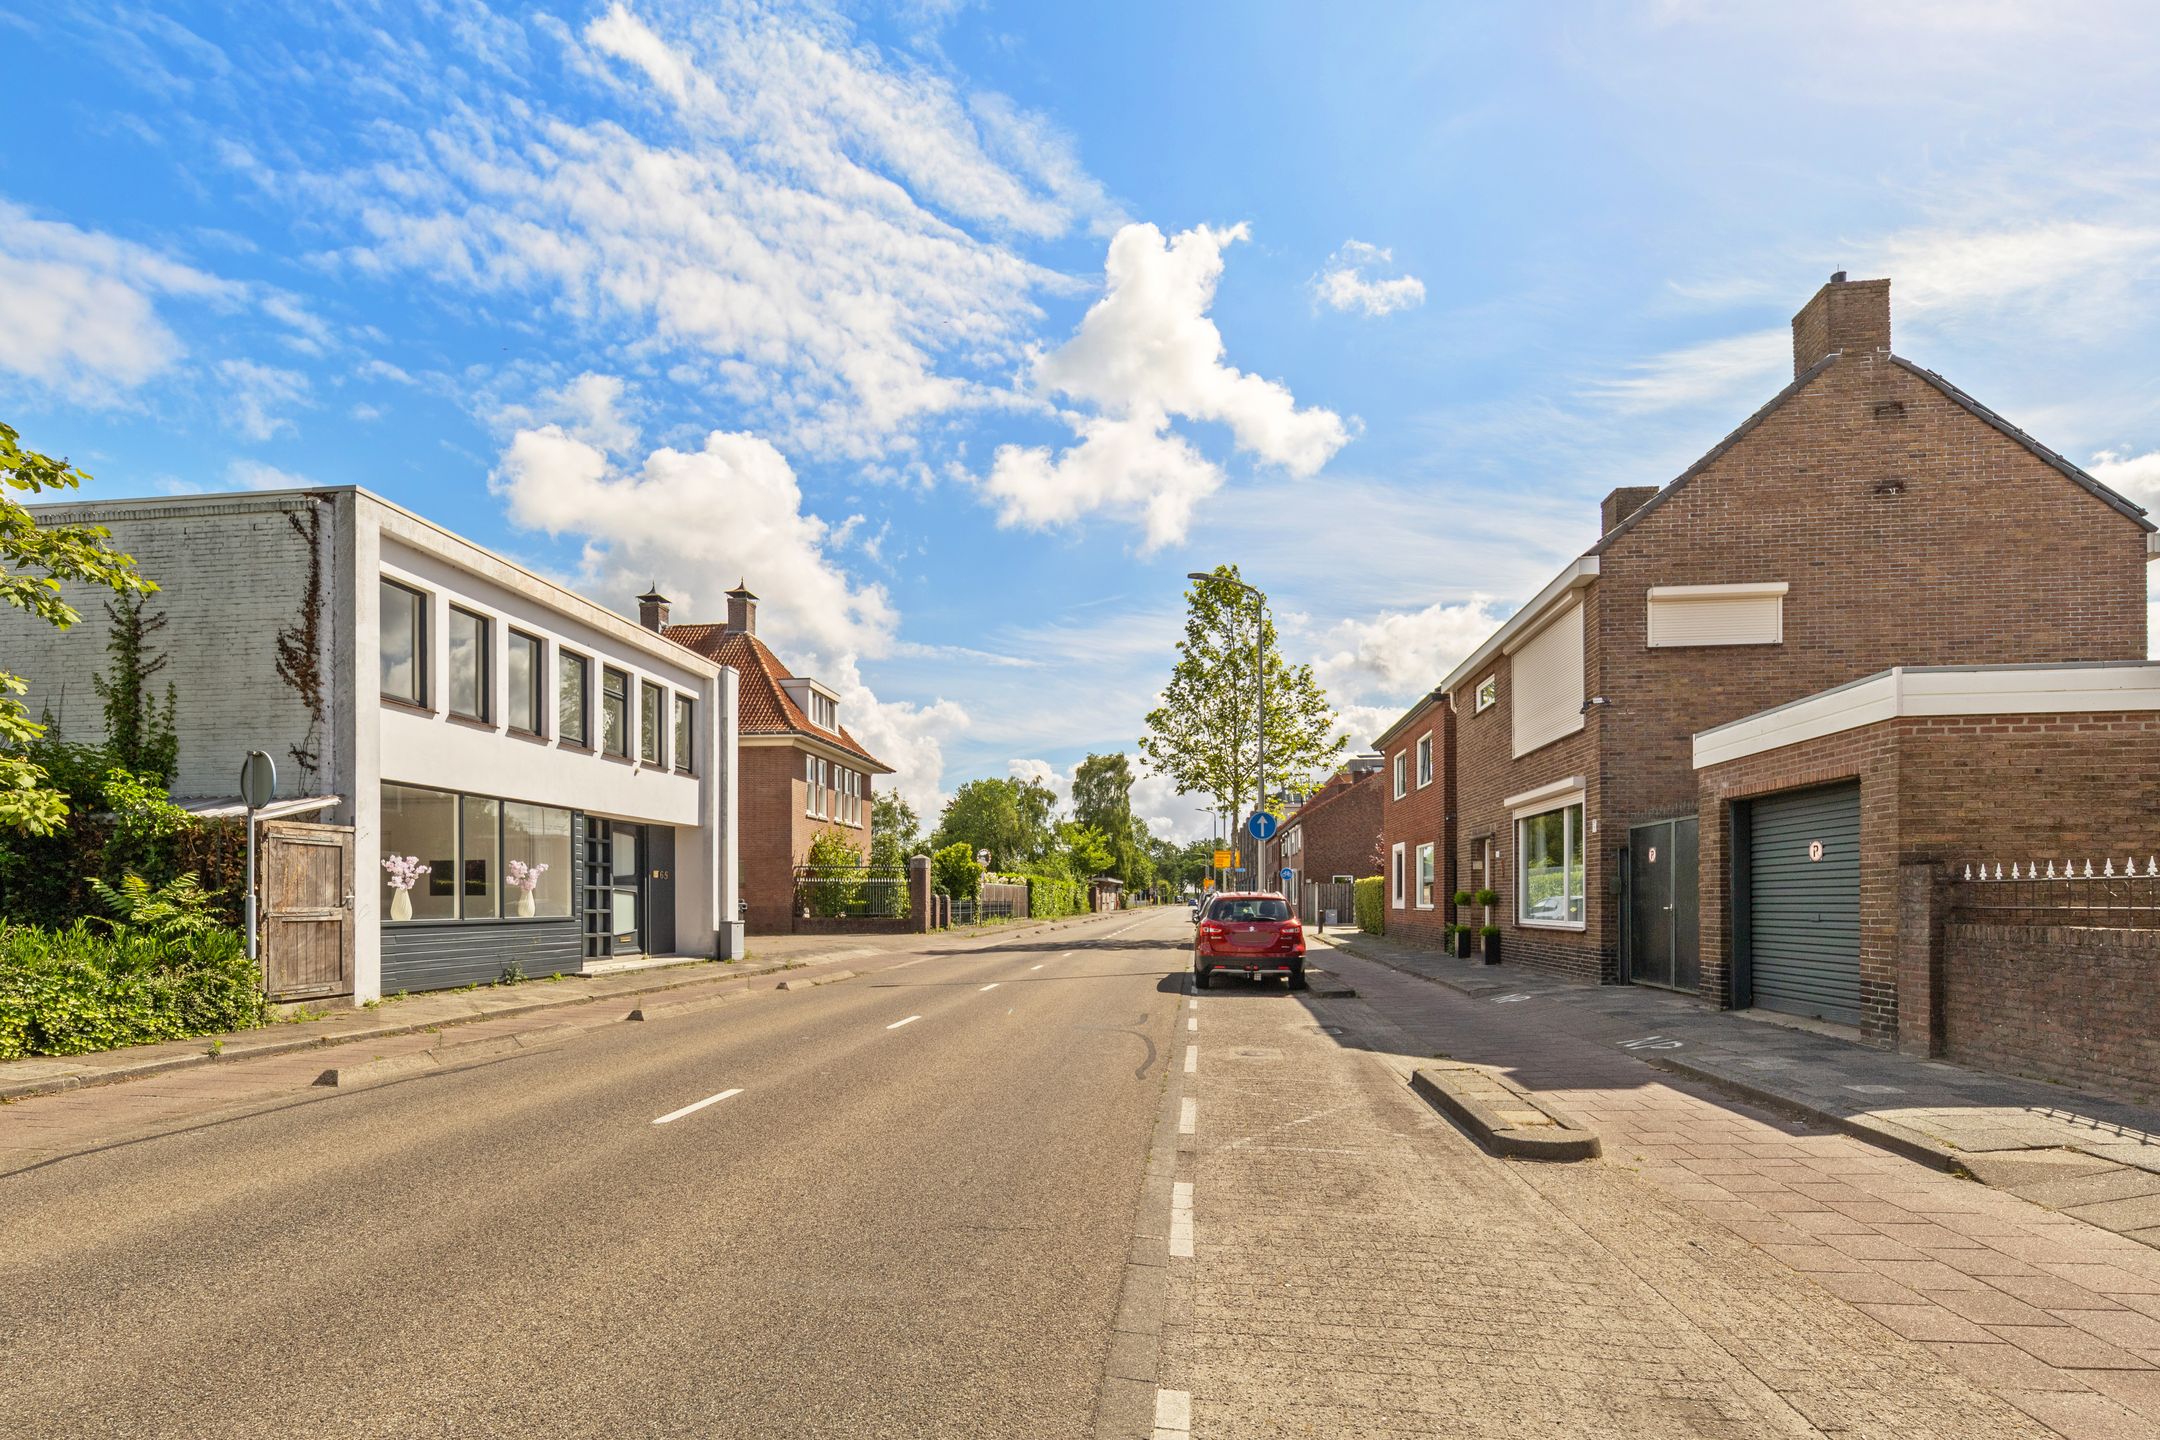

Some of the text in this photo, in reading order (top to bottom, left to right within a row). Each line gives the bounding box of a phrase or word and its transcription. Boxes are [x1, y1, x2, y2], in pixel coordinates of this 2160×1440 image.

[1813, 845, 1819, 857] P
[659, 870, 669, 880] 65
[1615, 1036, 1683, 1049] NP
